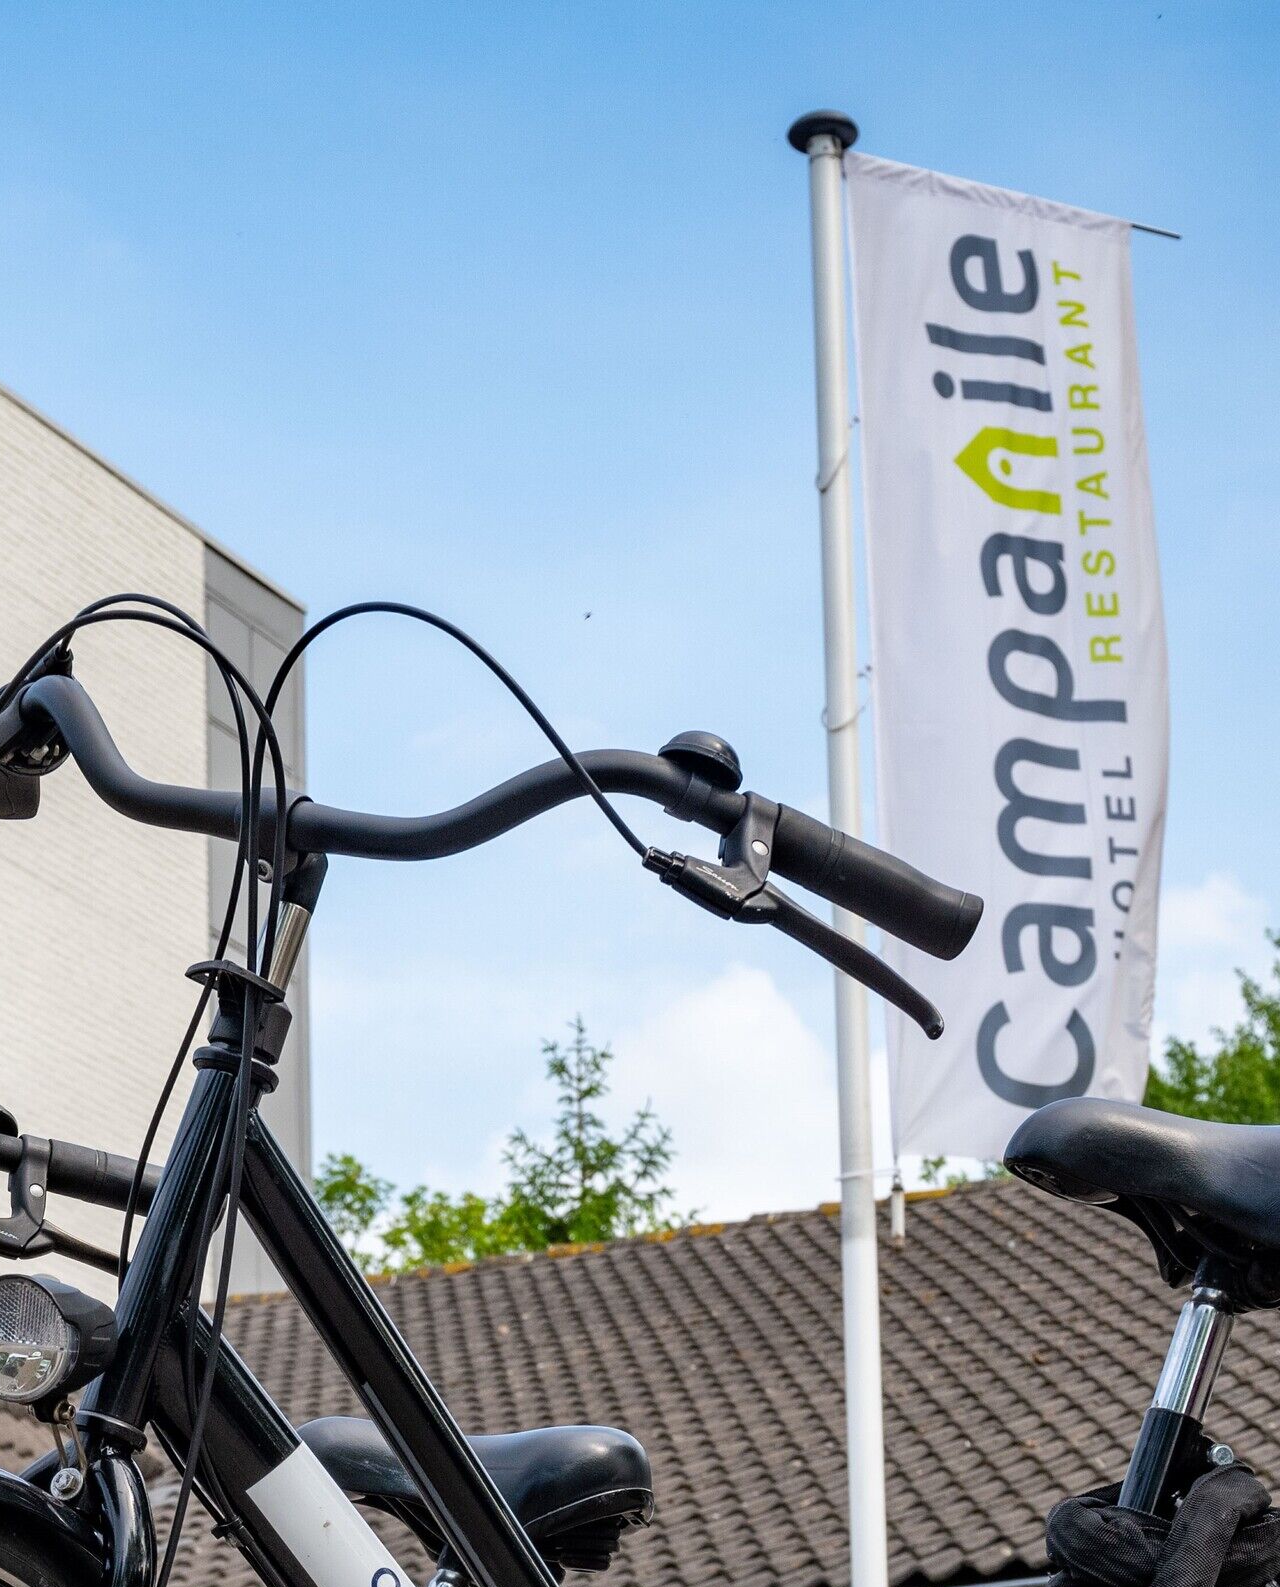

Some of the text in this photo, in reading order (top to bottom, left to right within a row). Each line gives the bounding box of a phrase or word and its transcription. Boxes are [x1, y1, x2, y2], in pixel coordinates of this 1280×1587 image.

[1051, 260, 1124, 663] RESTAURANT
[925, 233, 1127, 1110] Campanile
[1102, 755, 1139, 960] OTEL
